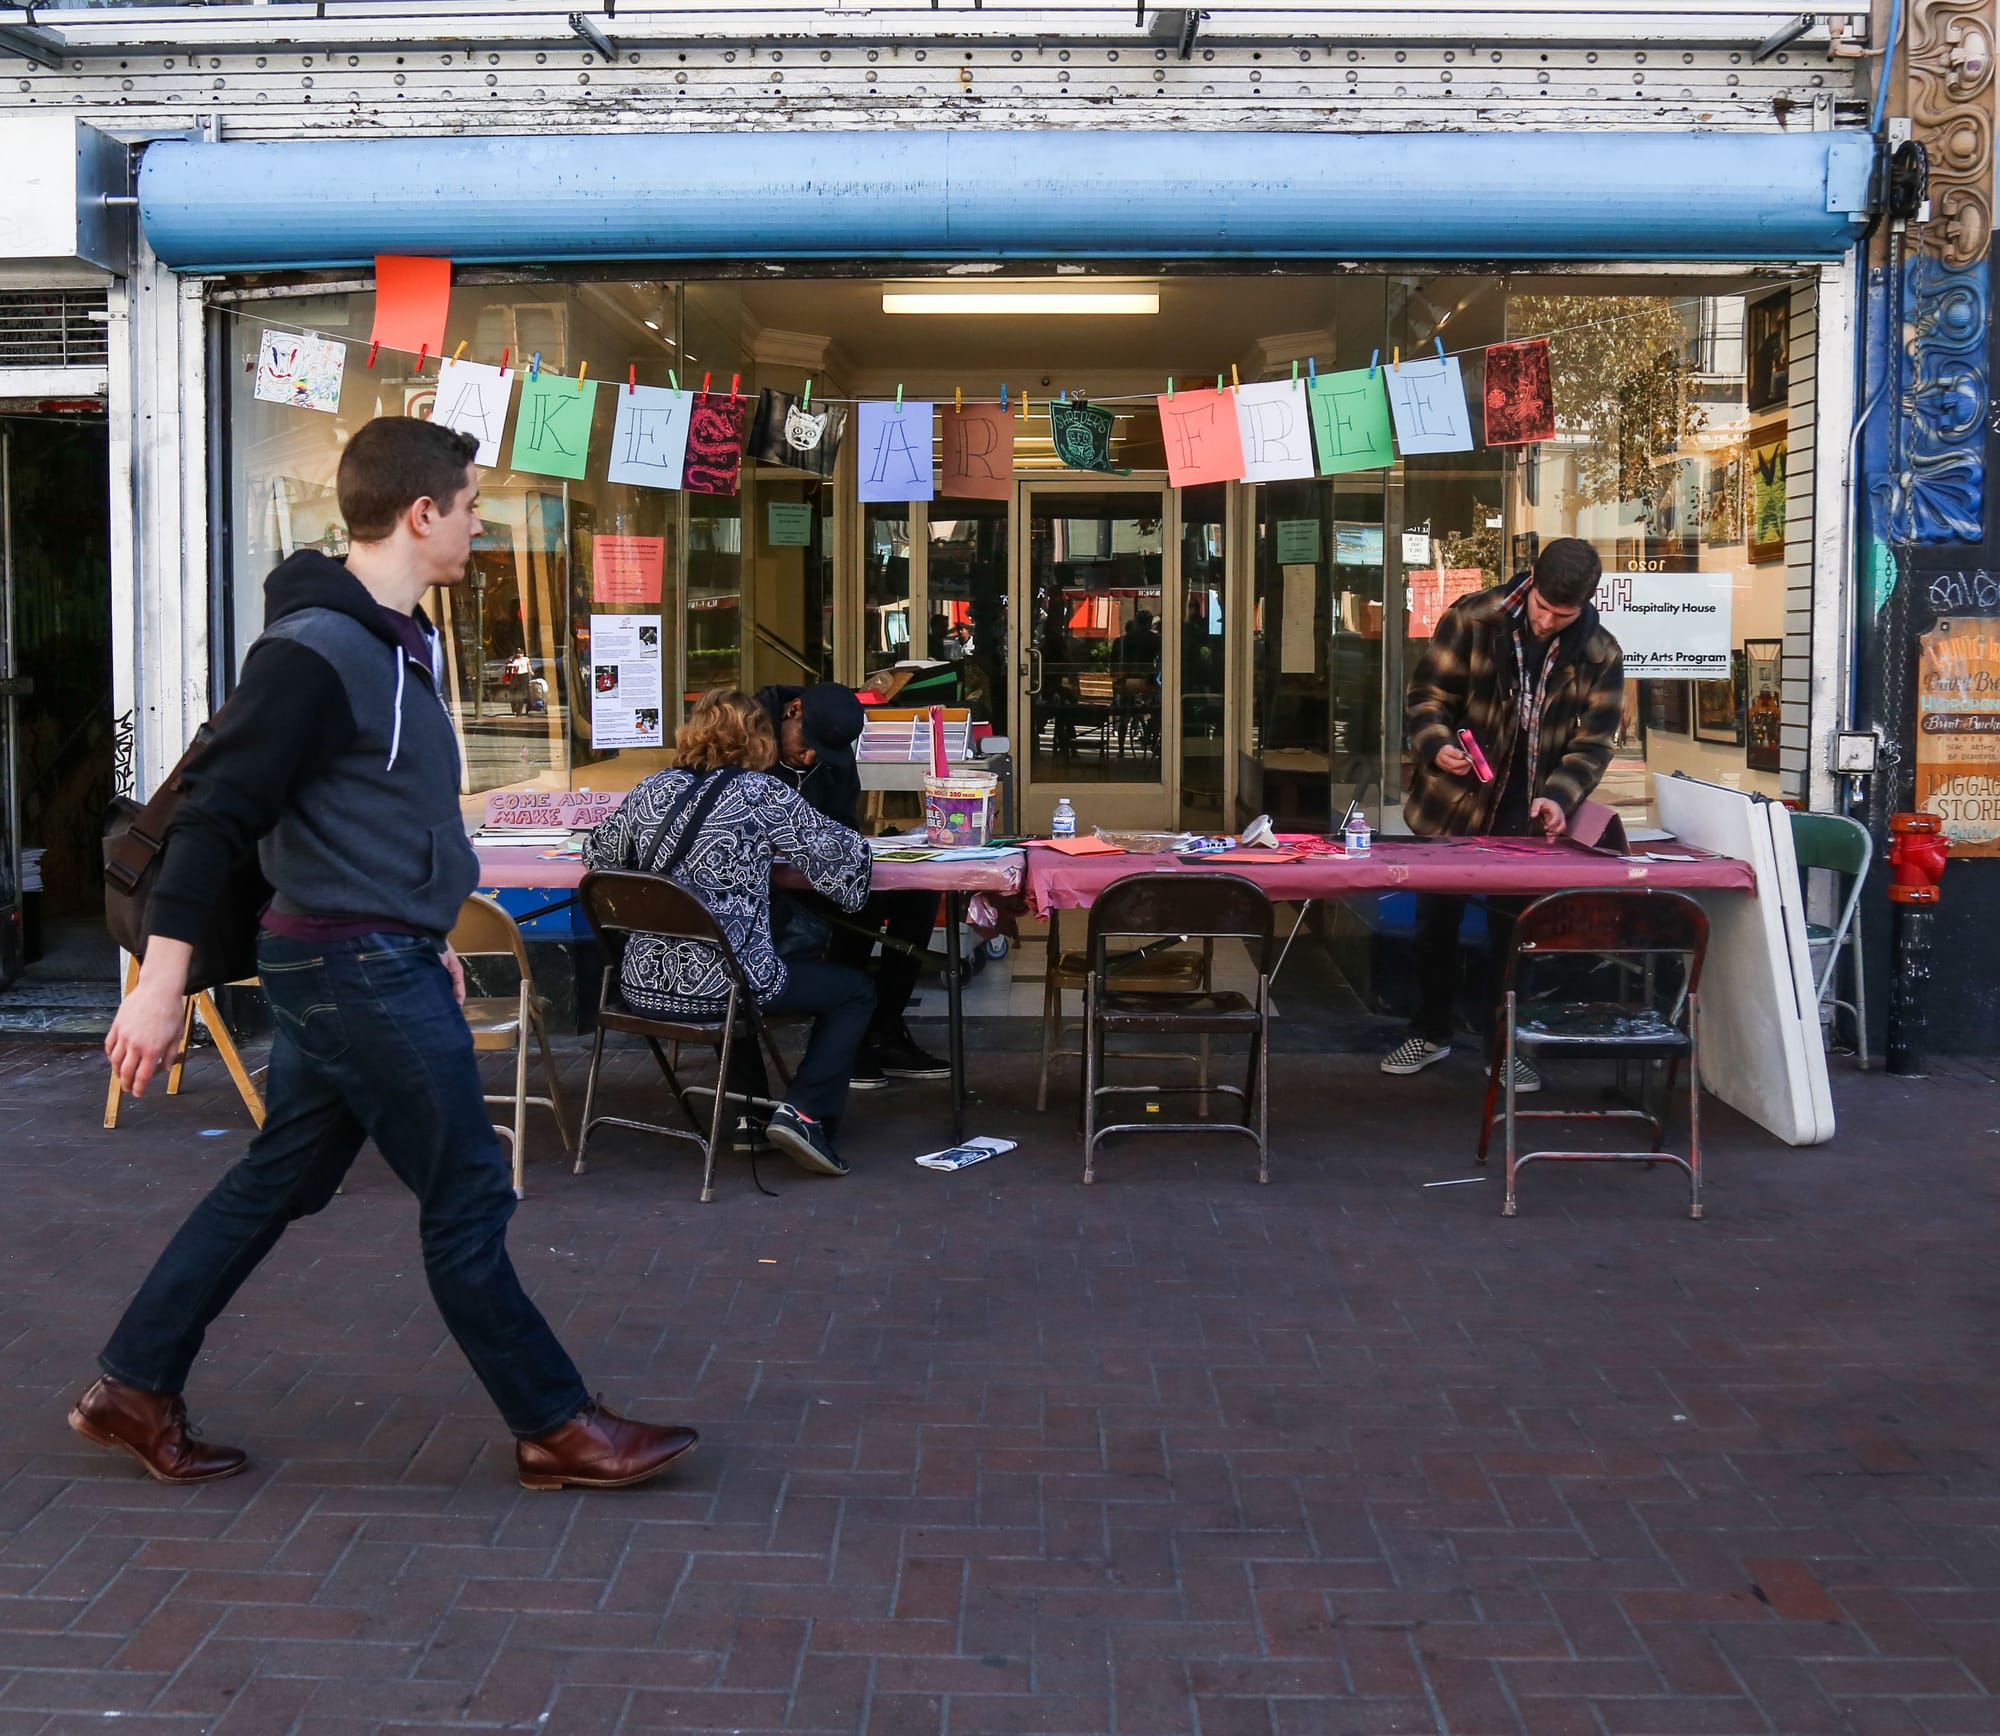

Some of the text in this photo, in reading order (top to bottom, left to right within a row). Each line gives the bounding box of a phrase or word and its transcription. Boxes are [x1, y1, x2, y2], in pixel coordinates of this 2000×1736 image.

[1623, 602, 1717, 615] Hospitality House
[1650, 652, 1673, 662] Arts
[1676, 652, 1727, 664] Program
[490, 792, 611, 809] COME AND
[492, 807, 563, 826] MAKE
